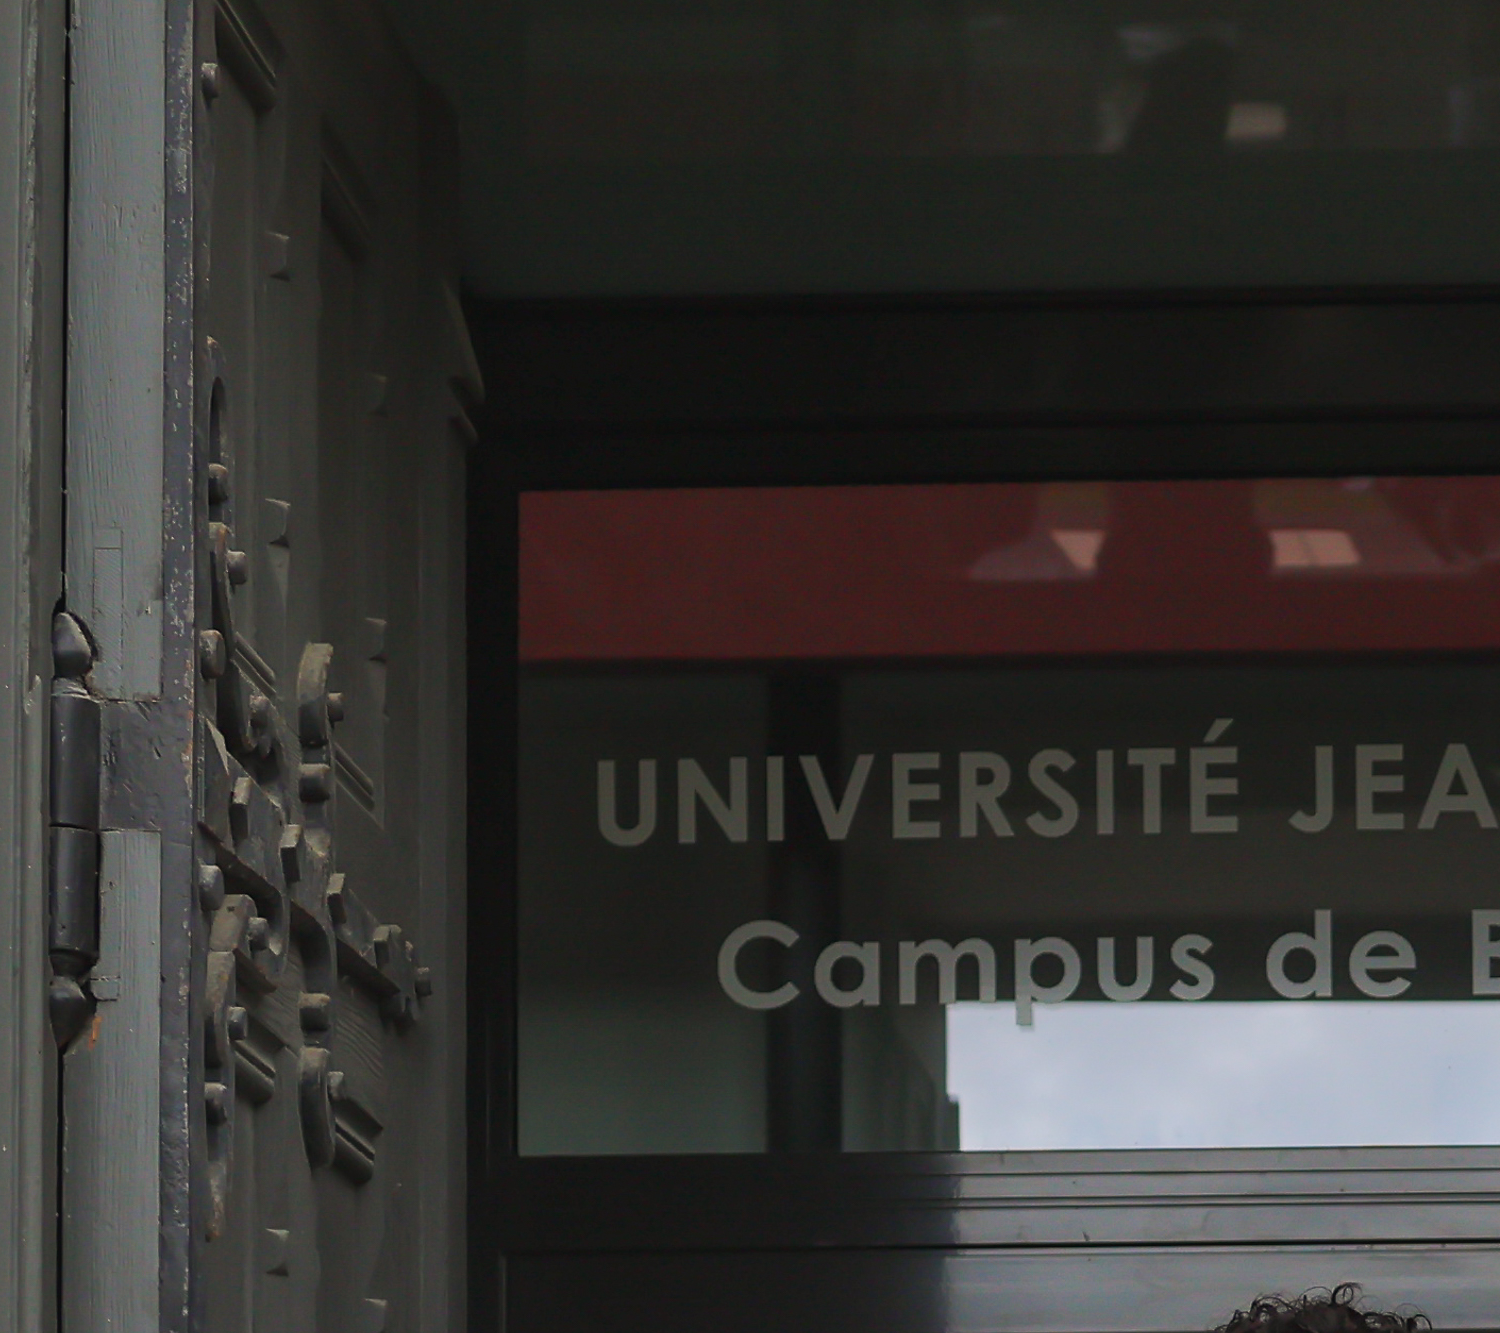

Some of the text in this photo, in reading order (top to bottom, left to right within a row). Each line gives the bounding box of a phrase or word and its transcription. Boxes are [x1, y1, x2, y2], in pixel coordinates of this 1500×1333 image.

[596, 718, 1240, 848] UNIVERSITÉ
[717, 919, 1216, 1027] Campus
[1265, 908, 1417, 1000] de
